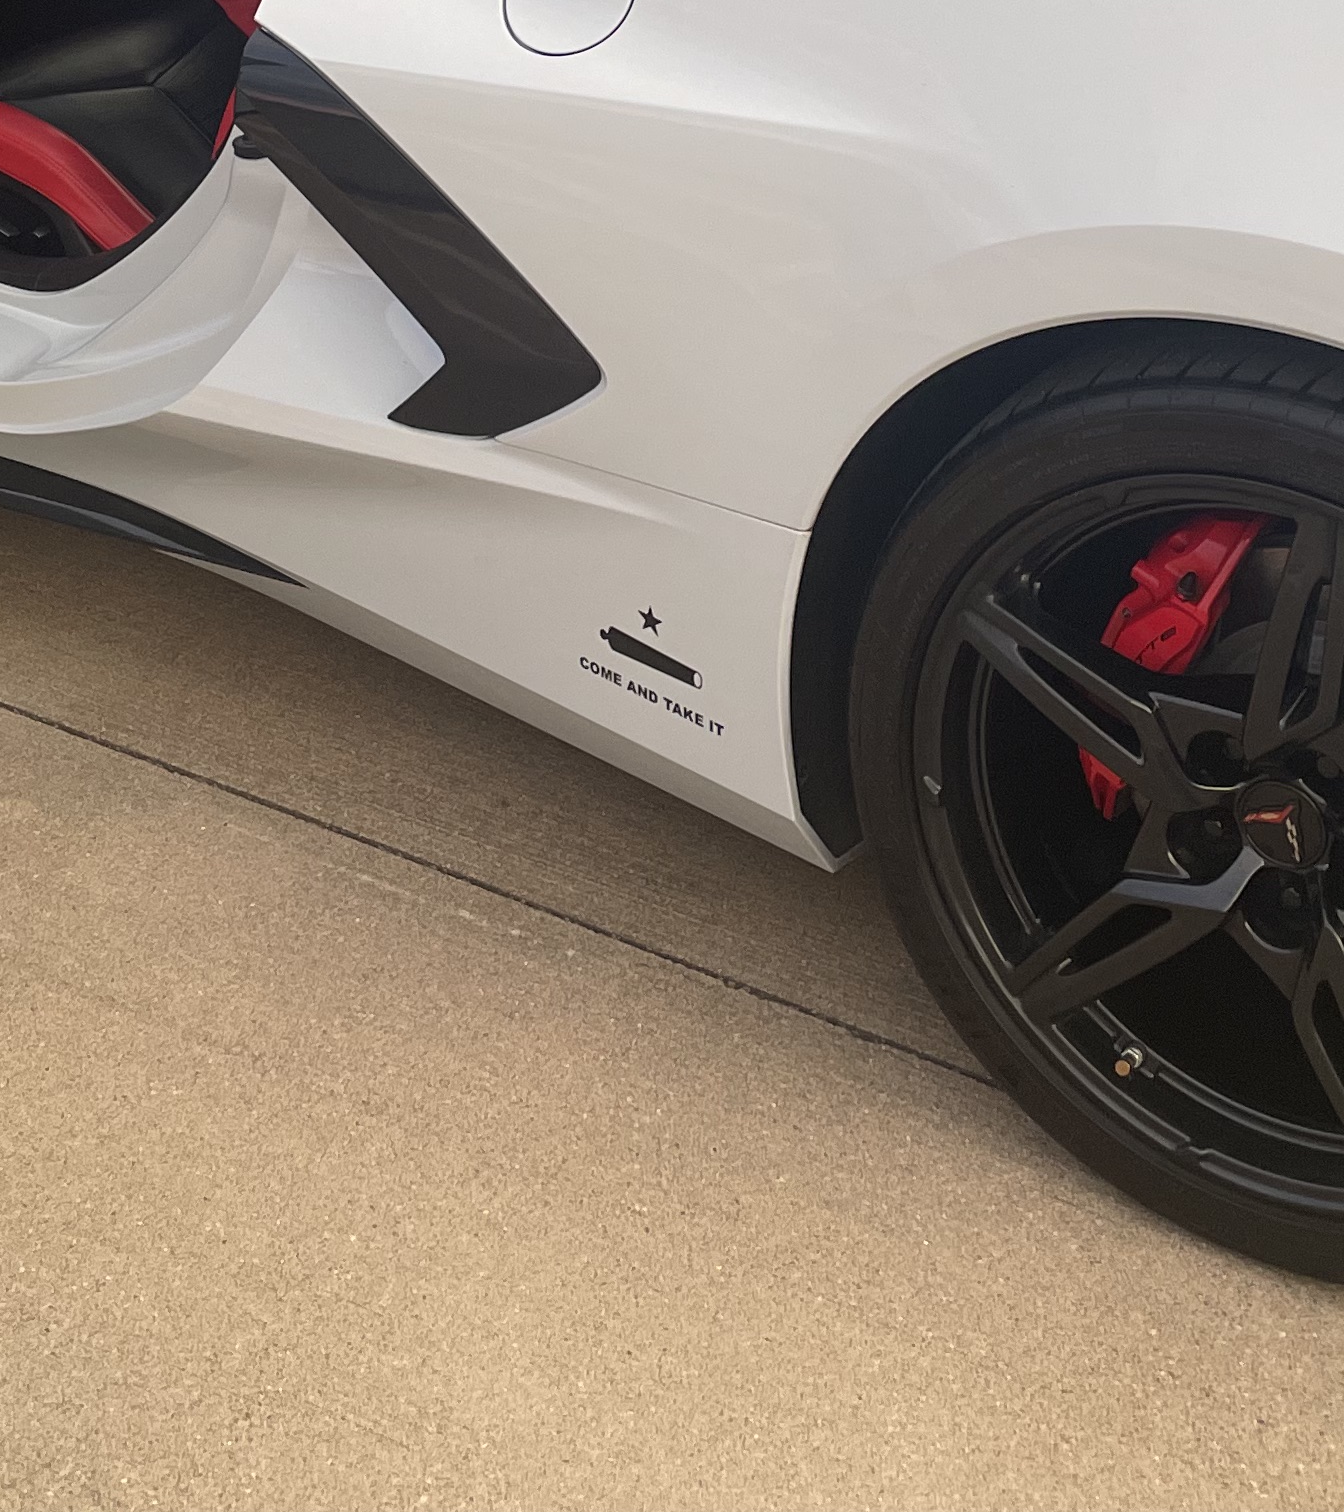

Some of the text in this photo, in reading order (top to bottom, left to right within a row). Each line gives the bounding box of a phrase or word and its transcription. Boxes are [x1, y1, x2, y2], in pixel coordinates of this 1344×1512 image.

[579, 657, 725, 736] COME AND TAKE IT
